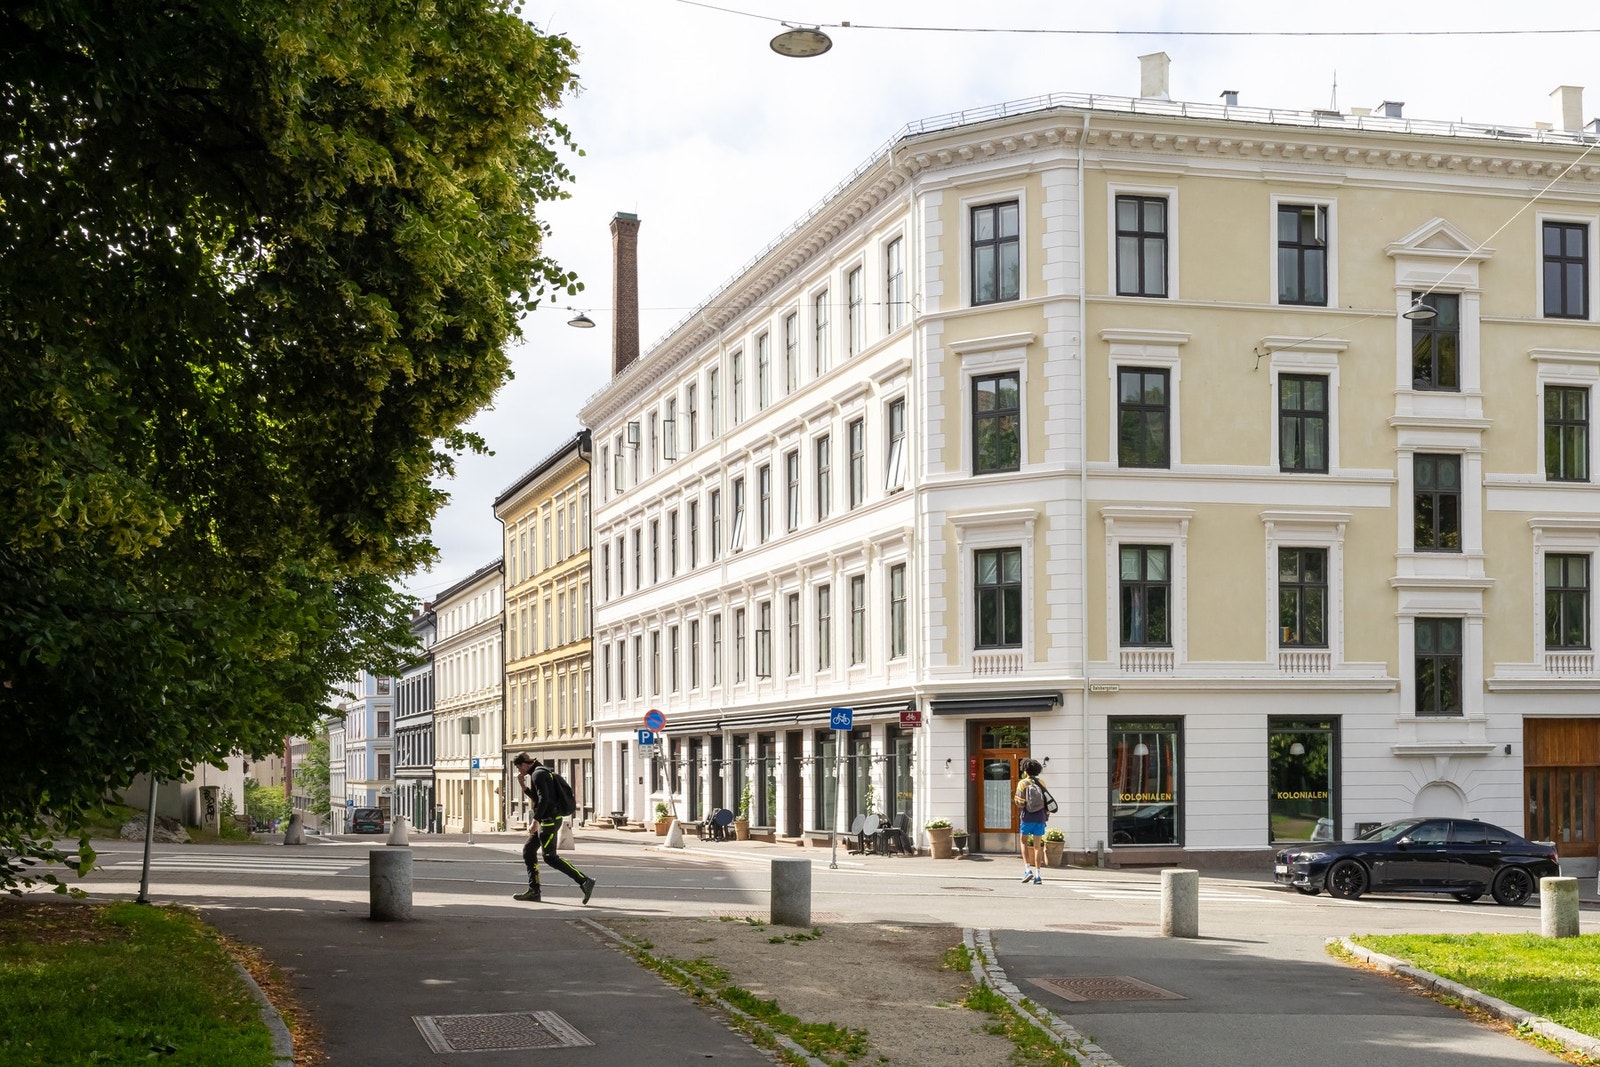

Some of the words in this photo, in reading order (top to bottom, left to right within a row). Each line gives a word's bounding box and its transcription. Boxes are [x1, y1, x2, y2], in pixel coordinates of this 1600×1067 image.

[642, 731, 650, 744] P
[1118, 792, 1172, 801] KOLONIALEN
[1277, 791, 1328, 800] KOLONIALEN
